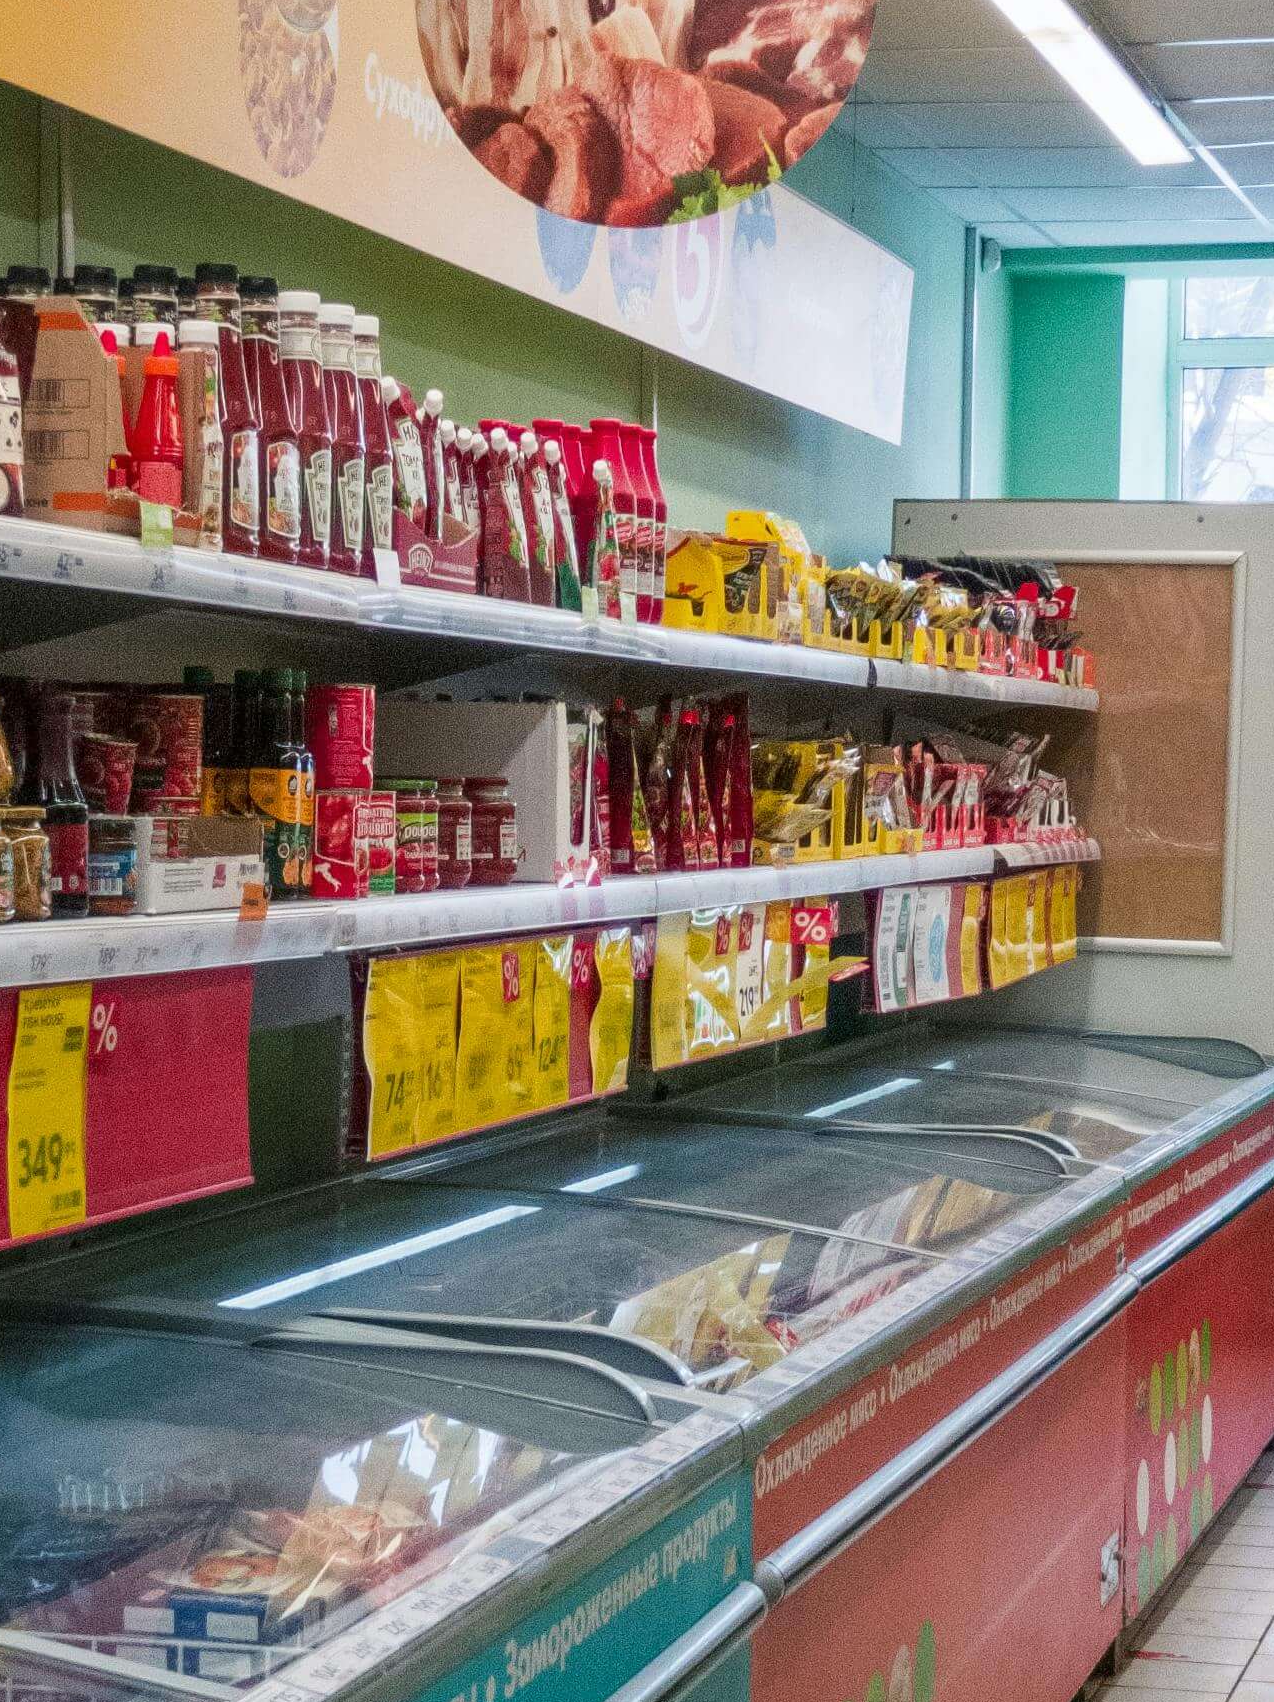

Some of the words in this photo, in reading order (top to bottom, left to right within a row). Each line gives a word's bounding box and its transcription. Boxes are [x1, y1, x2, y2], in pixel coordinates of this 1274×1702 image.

[754, 1408, 848, 1499] Охлажденное
[503, 1566, 659, 1699] Замороженные
[659, 1494, 739, 1584] продукты
